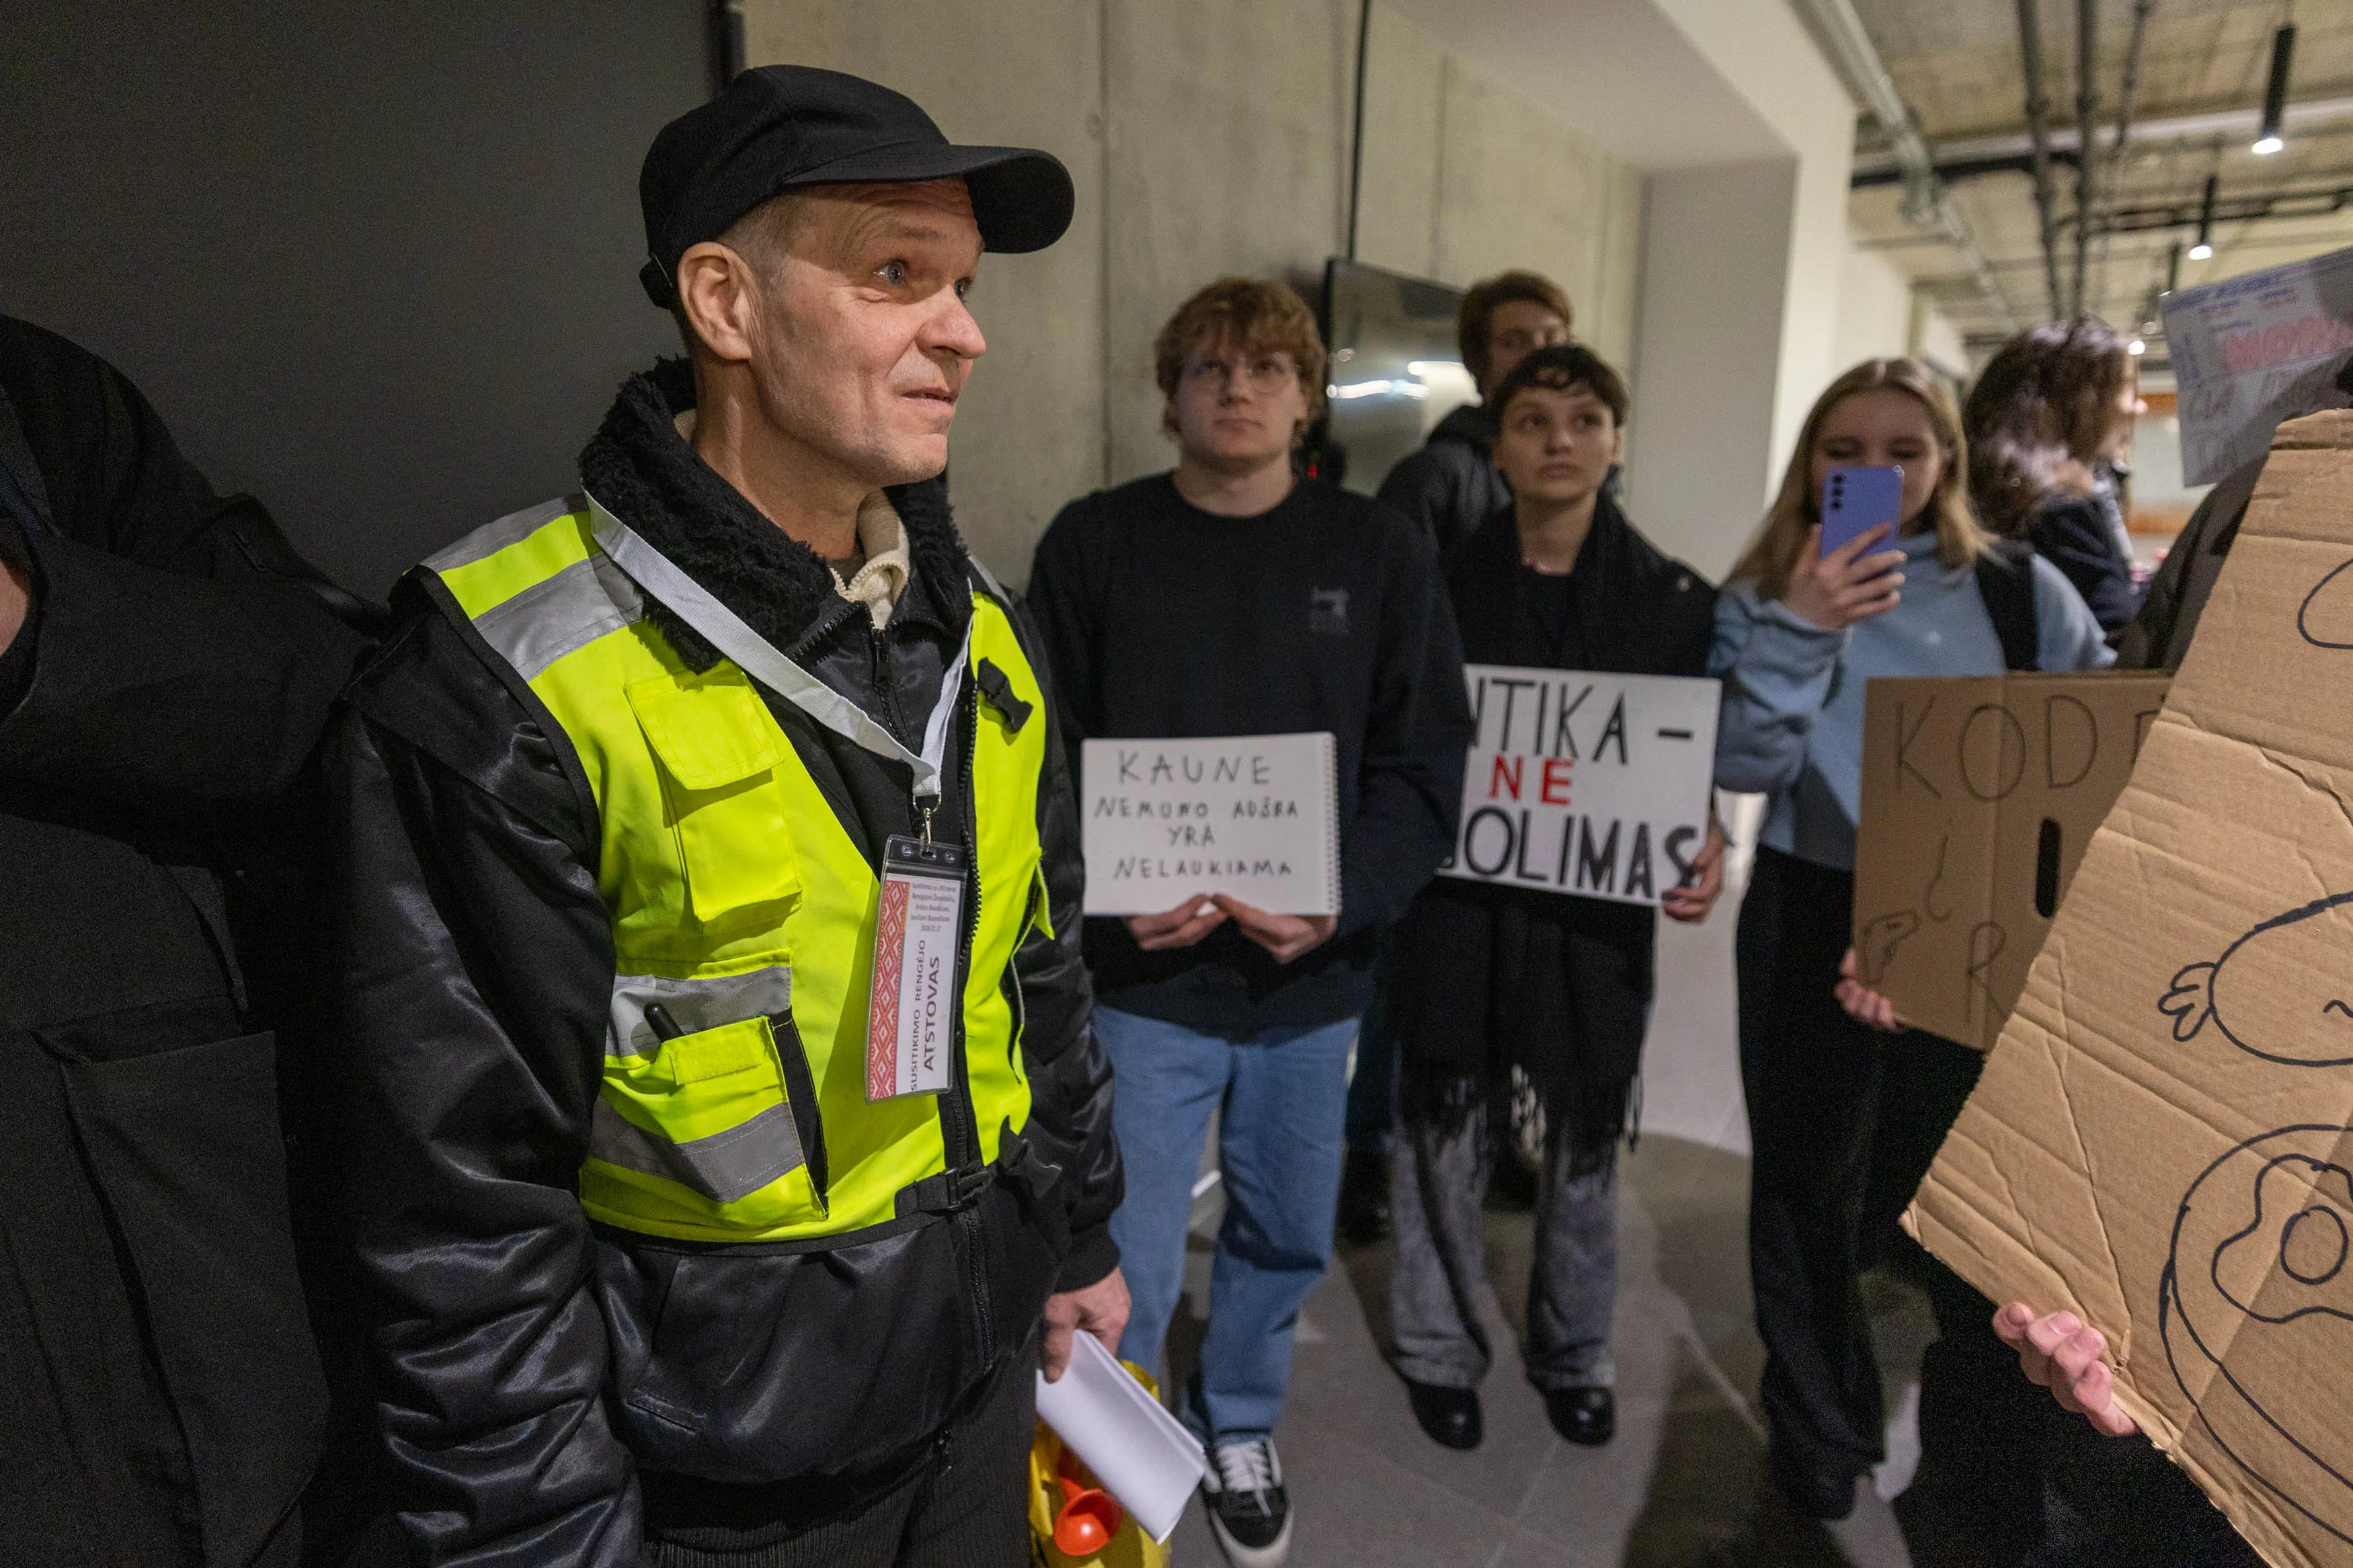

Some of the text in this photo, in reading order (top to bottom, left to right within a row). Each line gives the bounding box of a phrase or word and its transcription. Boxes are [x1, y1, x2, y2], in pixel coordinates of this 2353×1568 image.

[1118, 749, 1273, 784] KAUNE
[1488, 755, 1575, 806] NE
[1094, 796, 1298, 819] NEMUNO AUŠRA
[1167, 825, 1215, 847] YRA
[1445, 804, 1699, 901] OLIMAS
[1113, 856, 1292, 879] NELAUKIAMA
[911, 940, 926, 1091] SUSITIKIMO RENGĖJO
[924, 956, 940, 1071] ATSTOVAS
